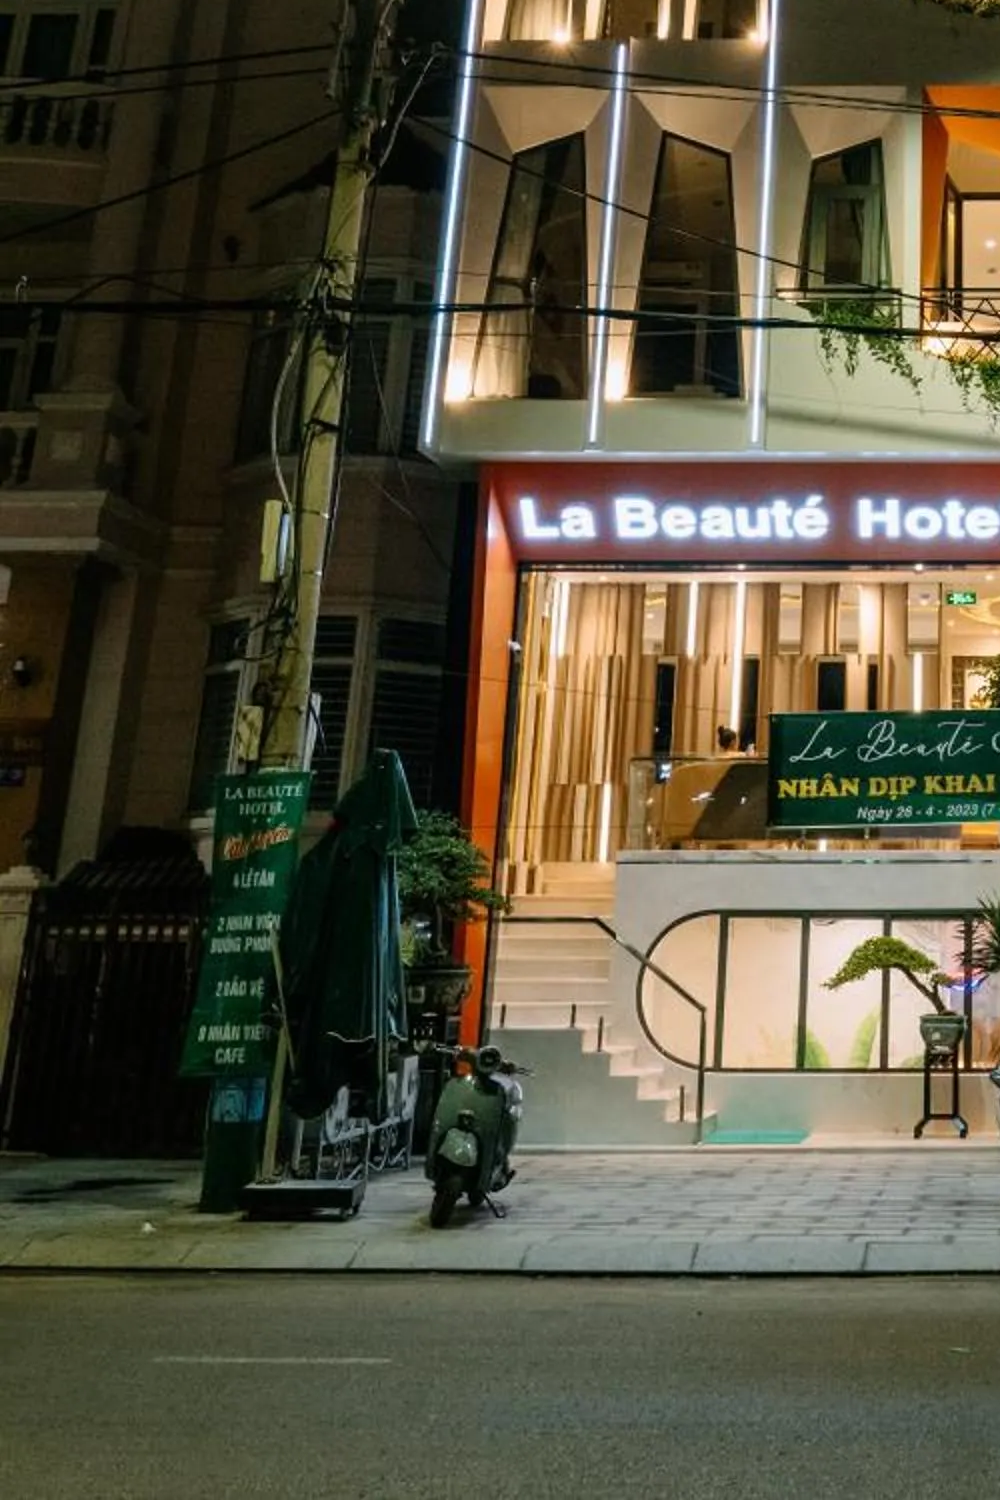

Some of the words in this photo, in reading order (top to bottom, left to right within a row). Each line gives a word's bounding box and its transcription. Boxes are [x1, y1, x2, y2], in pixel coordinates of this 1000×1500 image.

[519, 498, 597, 539] La
[614, 495, 829, 539] Beauté
[788, 720, 847, 764] La
[777, 772, 861, 799] NHÂN
[867, 775, 917, 801] DỊP
[923, 773, 997, 795] KHAI
[856, 805, 893, 822] Ngày
